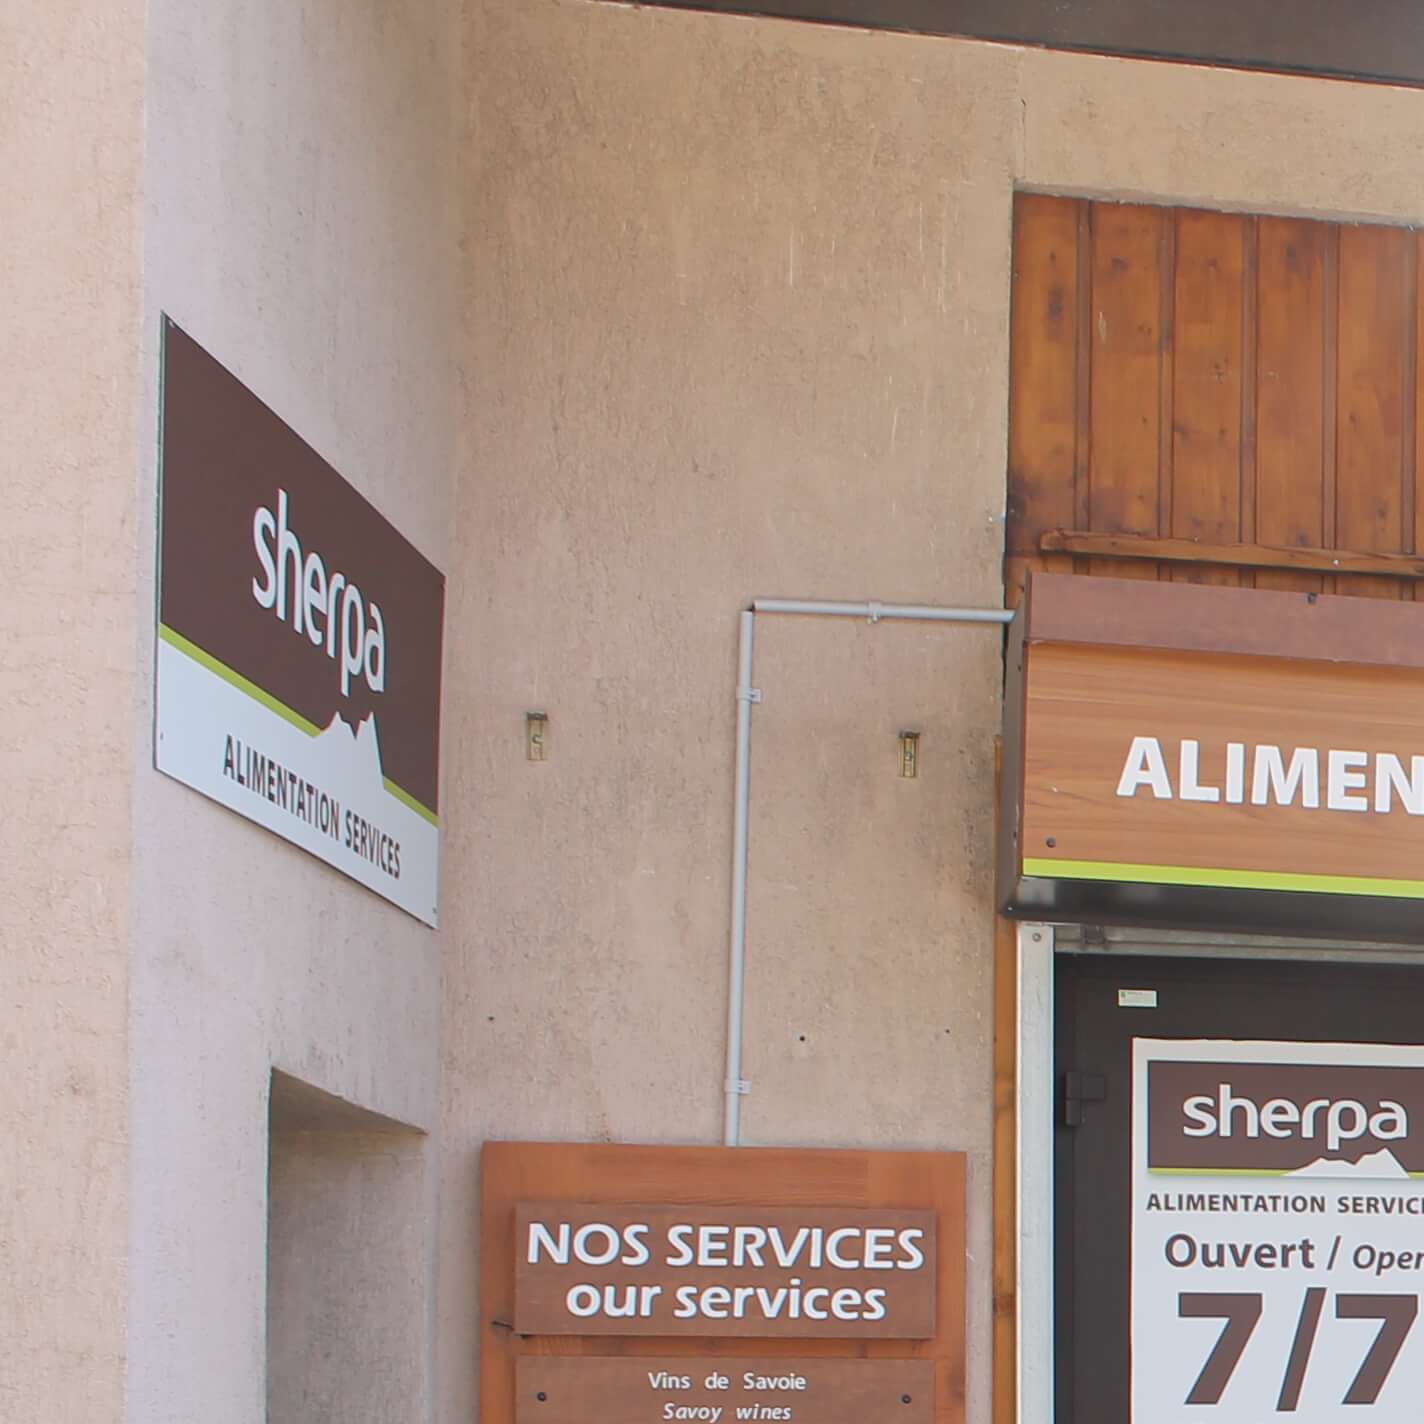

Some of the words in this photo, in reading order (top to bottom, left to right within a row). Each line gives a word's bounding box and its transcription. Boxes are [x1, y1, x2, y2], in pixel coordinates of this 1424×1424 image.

[252, 489, 384, 696] sherpa
[222, 735, 340, 840] ALIMENTATION
[345, 811, 401, 880] SERVICES
[1183, 1084, 1407, 1150] sherpa
[1146, 1194, 1325, 1213] ALIMENTATION
[527, 1223, 650, 1265] NOS
[666, 1225, 923, 1270] SERVICES
[1165, 1234, 1314, 1268] Ouvert
[566, 1283, 661, 1318] our
[674, 1278, 887, 1320] services
[1178, 1287, 1419, 1411] 7/7
[648, 1372, 690, 1389] Vins
[705, 1373, 728, 1390] de
[743, 1373, 806, 1390] Savoie
[663, 1403, 721, 1423] Savoy
[736, 1405, 791, 1420] wines
